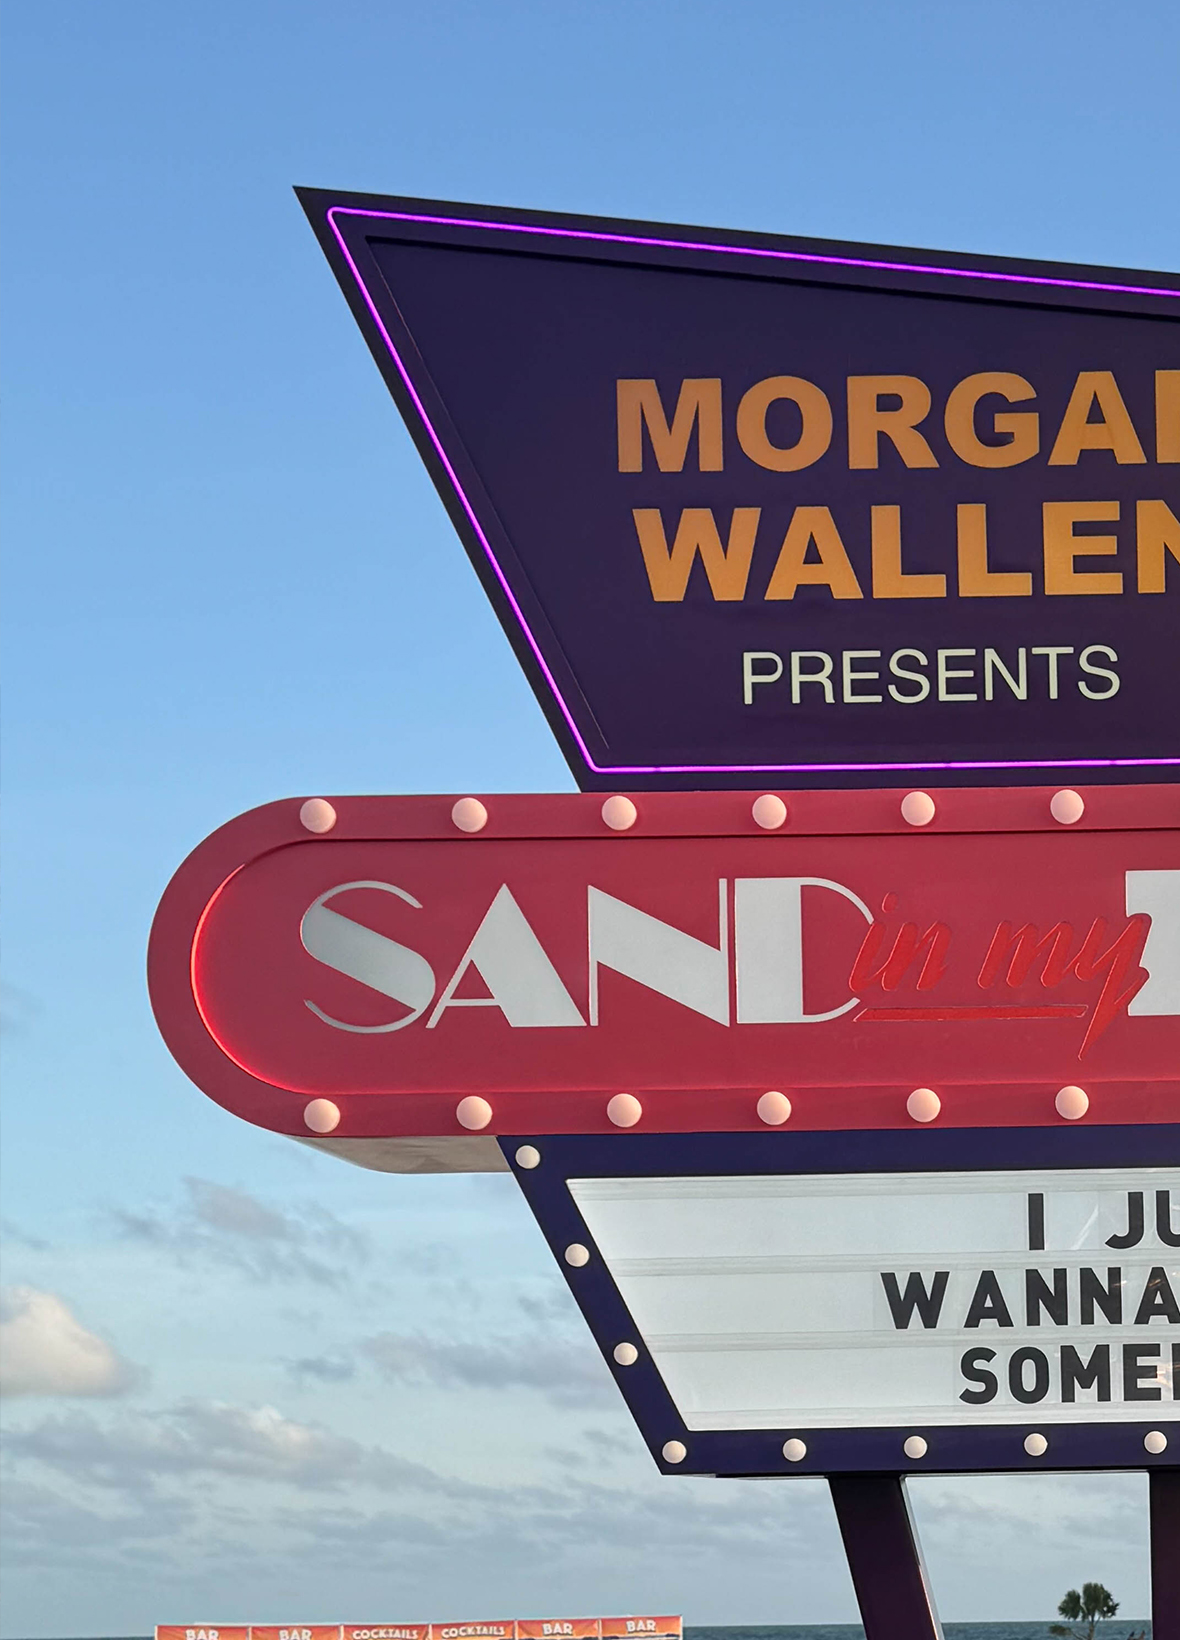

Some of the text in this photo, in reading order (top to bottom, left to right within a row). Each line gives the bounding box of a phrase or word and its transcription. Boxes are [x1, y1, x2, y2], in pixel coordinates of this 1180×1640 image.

[742, 644, 1121, 705] PRESENTS
[300, 877, 875, 1034] SAND
[849, 891, 951, 992] in
[977, 912, 1153, 1061] my
[1027, 1193, 1045, 1251] I
[441, 1625, 505, 1638] COCKTAILS
[542, 1623, 573, 1635] BAR
[626, 1619, 656, 1632] BAR
[185, 1629, 219, 1640] BAR
[279, 1629, 312, 1640] BAR
[352, 1628, 418, 1640] COCKTAILS
